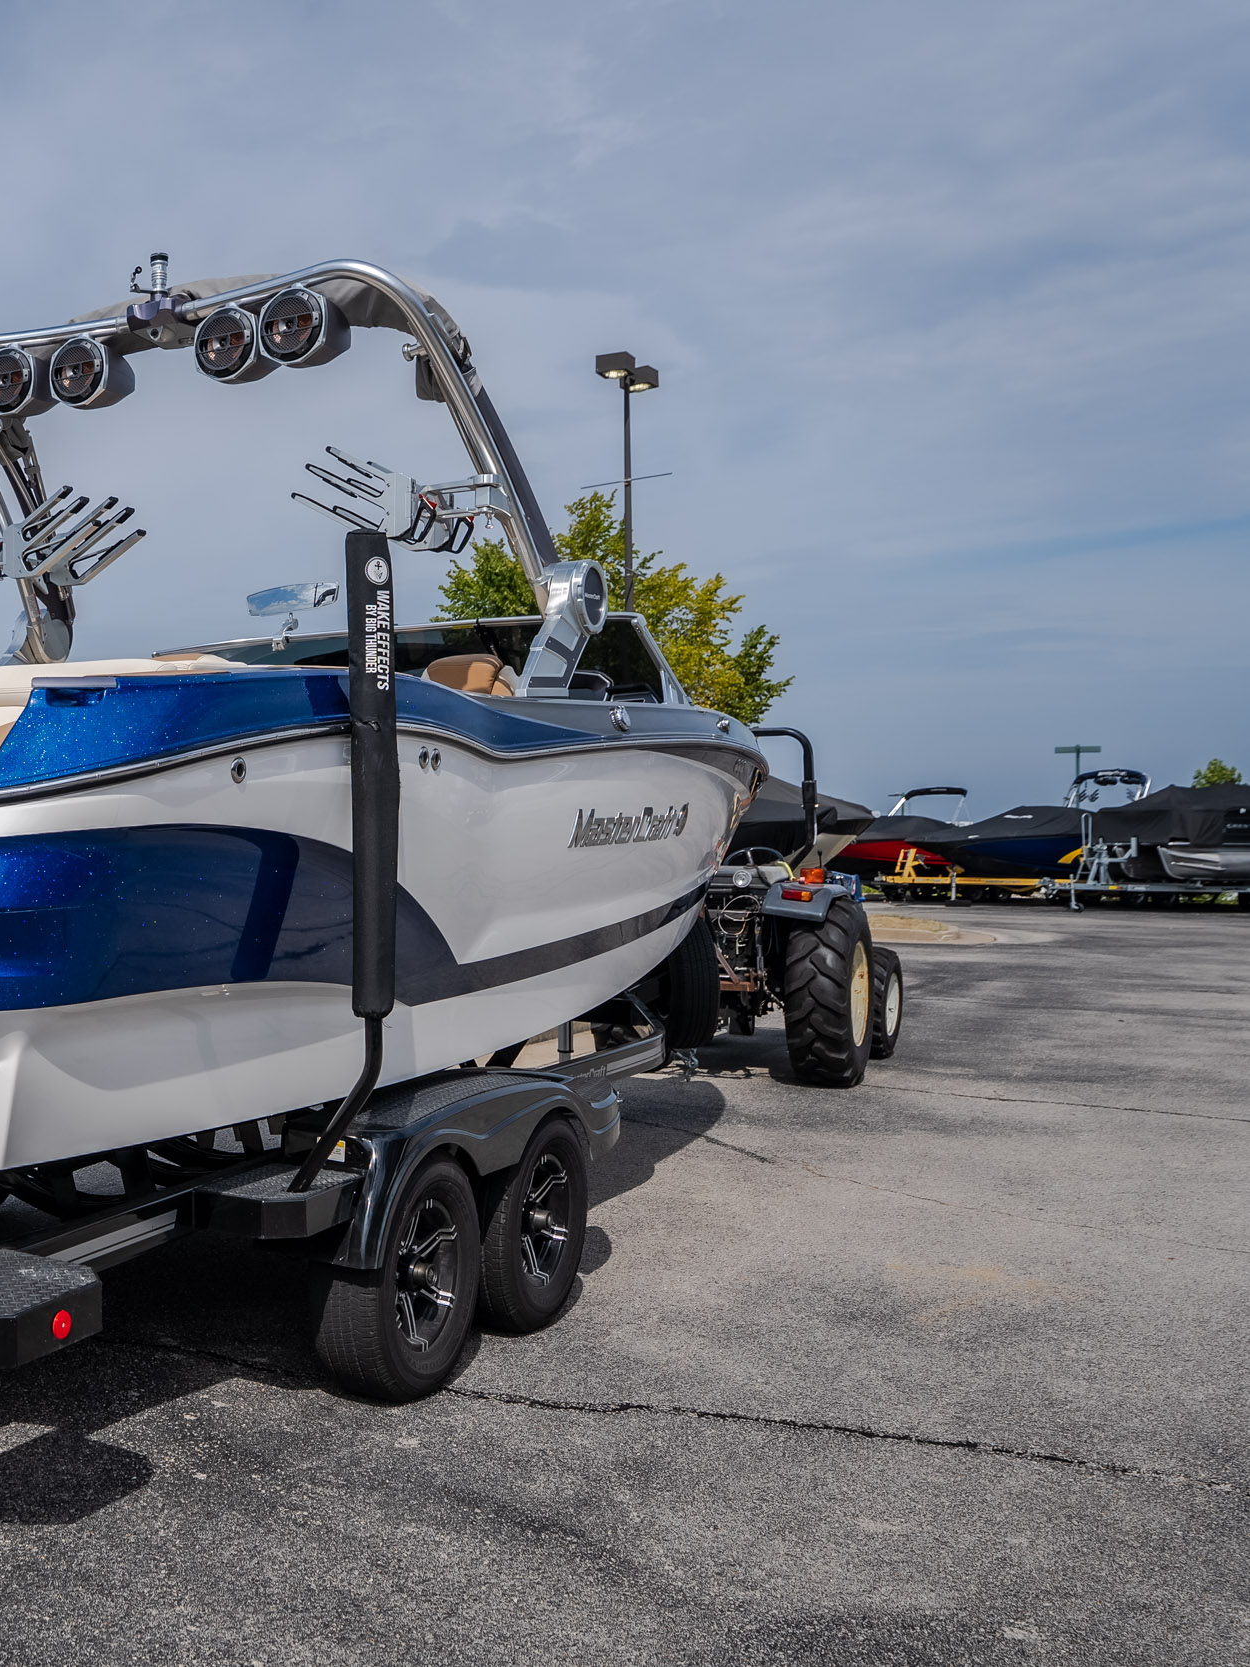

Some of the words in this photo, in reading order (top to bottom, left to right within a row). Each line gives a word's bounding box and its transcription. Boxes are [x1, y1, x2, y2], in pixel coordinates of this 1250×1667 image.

[365, 604, 377, 617] BY
[365, 617, 377, 632] BIG
[376, 590, 390, 630] WAKE
[365, 633, 377, 674] THUNDER
[376, 631, 390, 691] EFFECTS
[567, 806, 678, 848] MasterCraft
